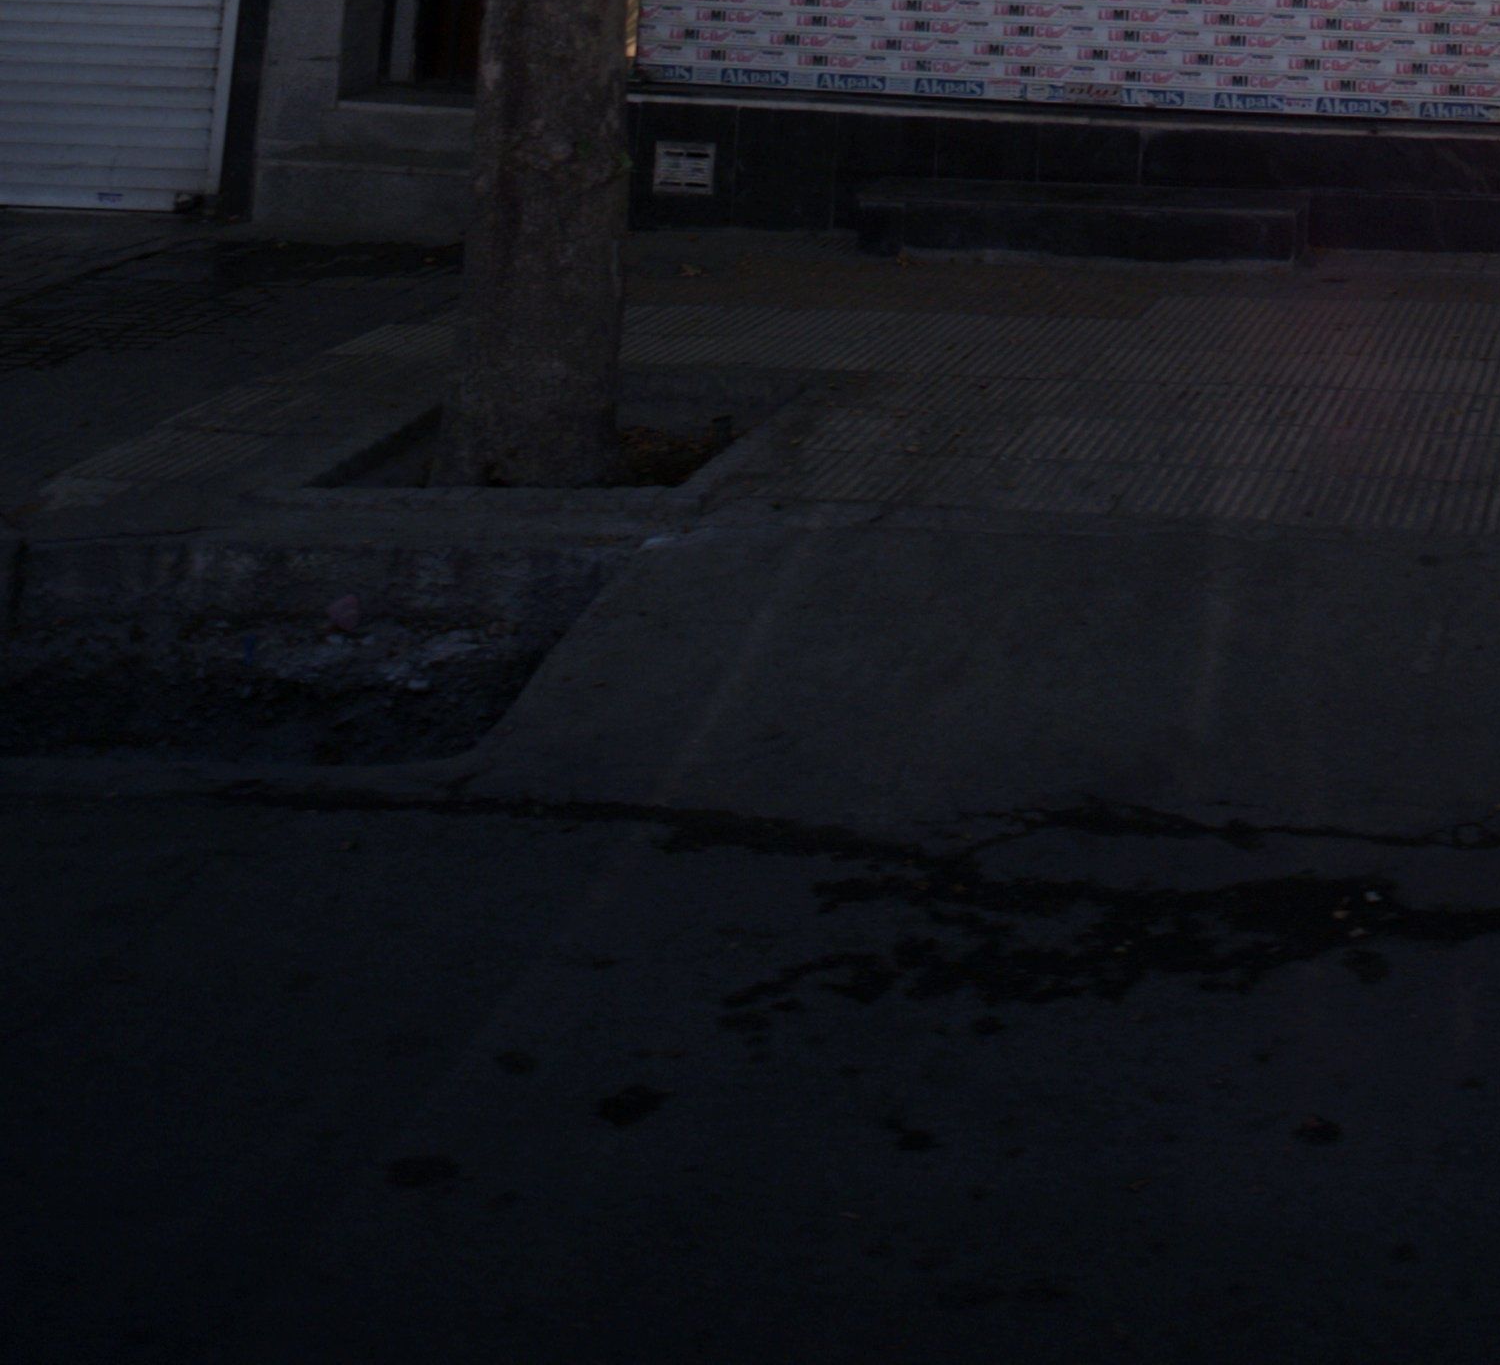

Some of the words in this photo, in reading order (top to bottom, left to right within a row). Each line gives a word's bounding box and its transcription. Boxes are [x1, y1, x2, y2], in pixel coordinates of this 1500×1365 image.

[892, 0, 941, 12] LUMICO
[797, 15, 846, 28] LUMICO
[1098, 9, 1149, 22] LUMICO
[1310, 18, 1362, 31] LUMICO
[1003, 25, 1054, 38] LUMICO
[870, 39, 922, 52] LUMICO
[1214, 34, 1267, 48] LUMICO
[1077, 49, 1128, 62] LUMICO
